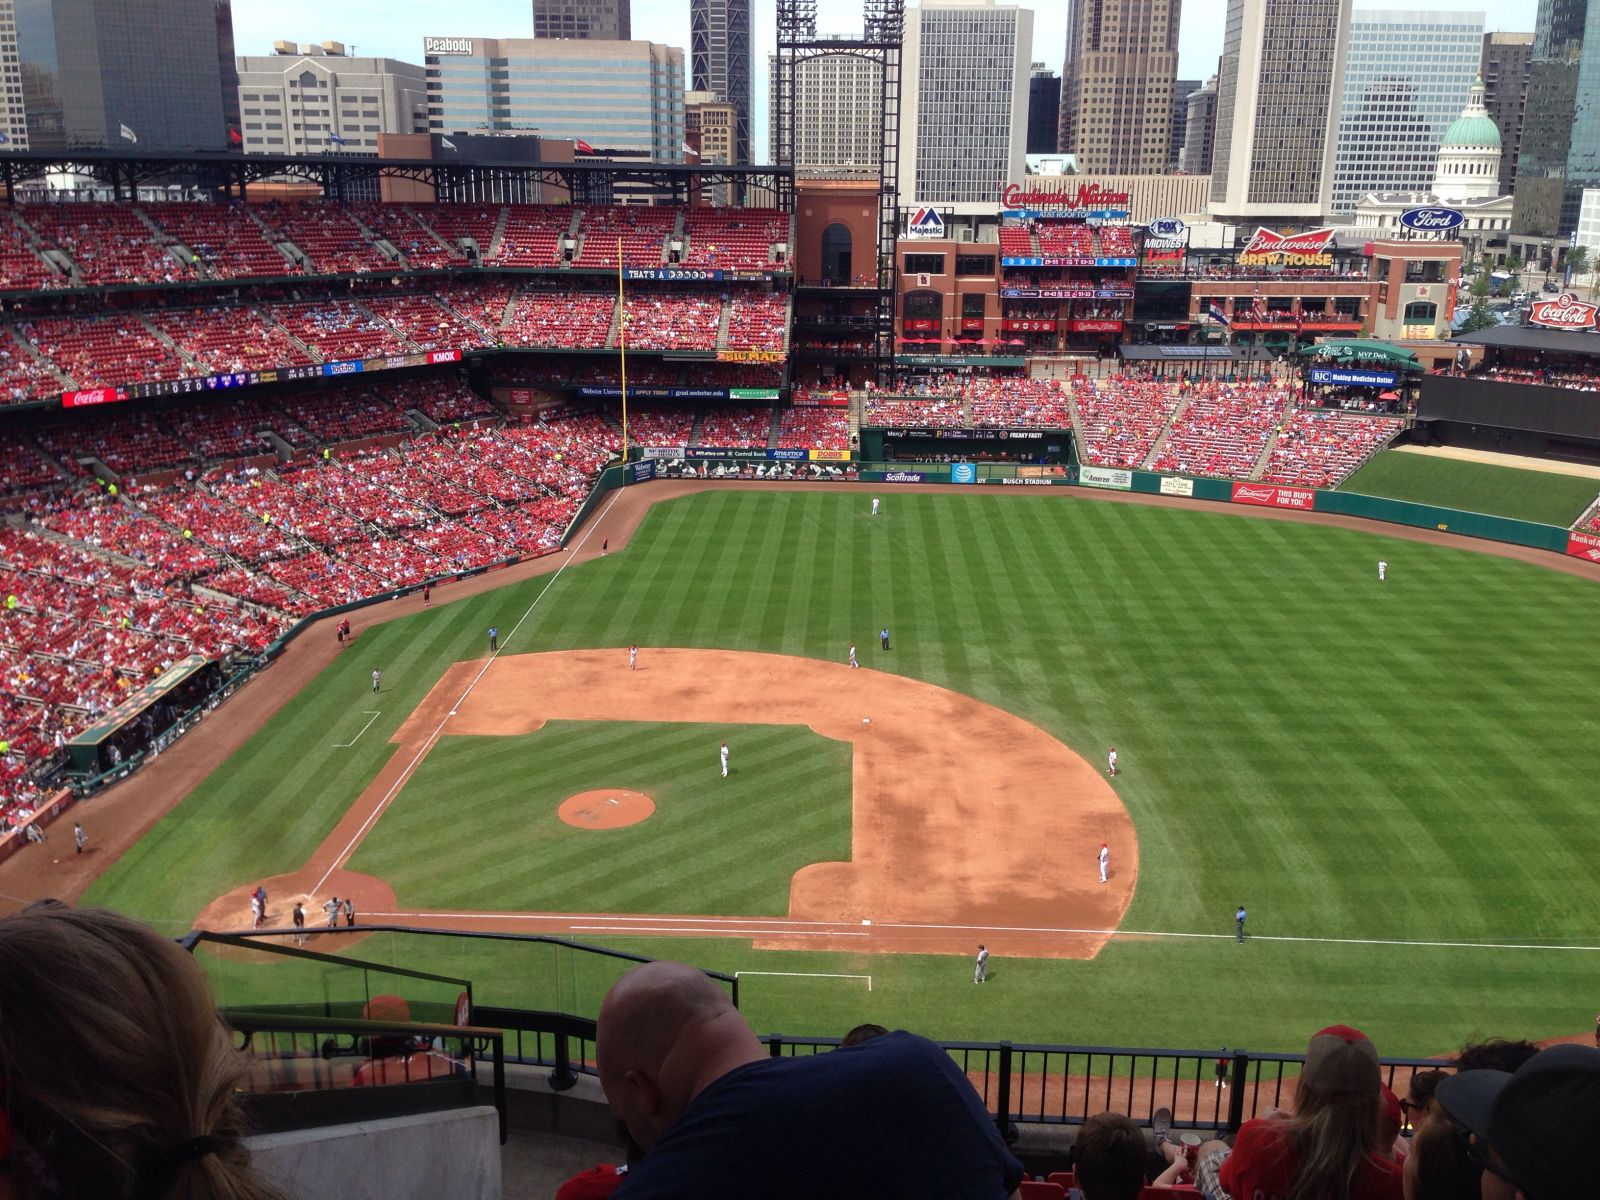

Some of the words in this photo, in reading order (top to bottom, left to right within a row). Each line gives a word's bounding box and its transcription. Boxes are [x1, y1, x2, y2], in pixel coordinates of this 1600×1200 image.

[426, 38, 472, 55] Peabody
[1002, 184, 1069, 208] Cardinals
[1068, 184, 1128, 208] Nation
[1413, 211, 1452, 226] Ford
[910, 226, 942, 235] Majestic
[1157, 221, 1177, 230] FOX
[1144, 239, 1186, 248] MIDWEST
[1241, 236, 1332, 251] Budweiser
[1239, 254, 1280, 265] BREW
[1283, 254, 1332, 265] HOUSE
[629, 270, 655, 279] THAT'S
[658, 270, 664, 279] A
[1538, 304, 1588, 323] Coca-Cola
[433, 351, 455, 362] KMOX
[749, 351, 779, 361] MAC
[1314, 371, 1329, 381] BJC
[1332, 374, 1351, 382] Making
[1352, 375, 1376, 383] Medicine
[1377, 376, 1393, 384] Better
[172, 385, 178, 393] 0
[184, 384, 191, 392] 2
[196, 382, 201, 391] 0
[74, 389, 104, 406] Coca-Cola
[886, 472, 920, 482] Scottrade
[1088, 475, 1110, 483] Ameren
[1239, 488, 1270, 498] Budweiser
[1293, 491, 1313, 499] BUD'S
[1571, 533, 1588, 544] Bank
[1588, 537, 1596, 546] of
